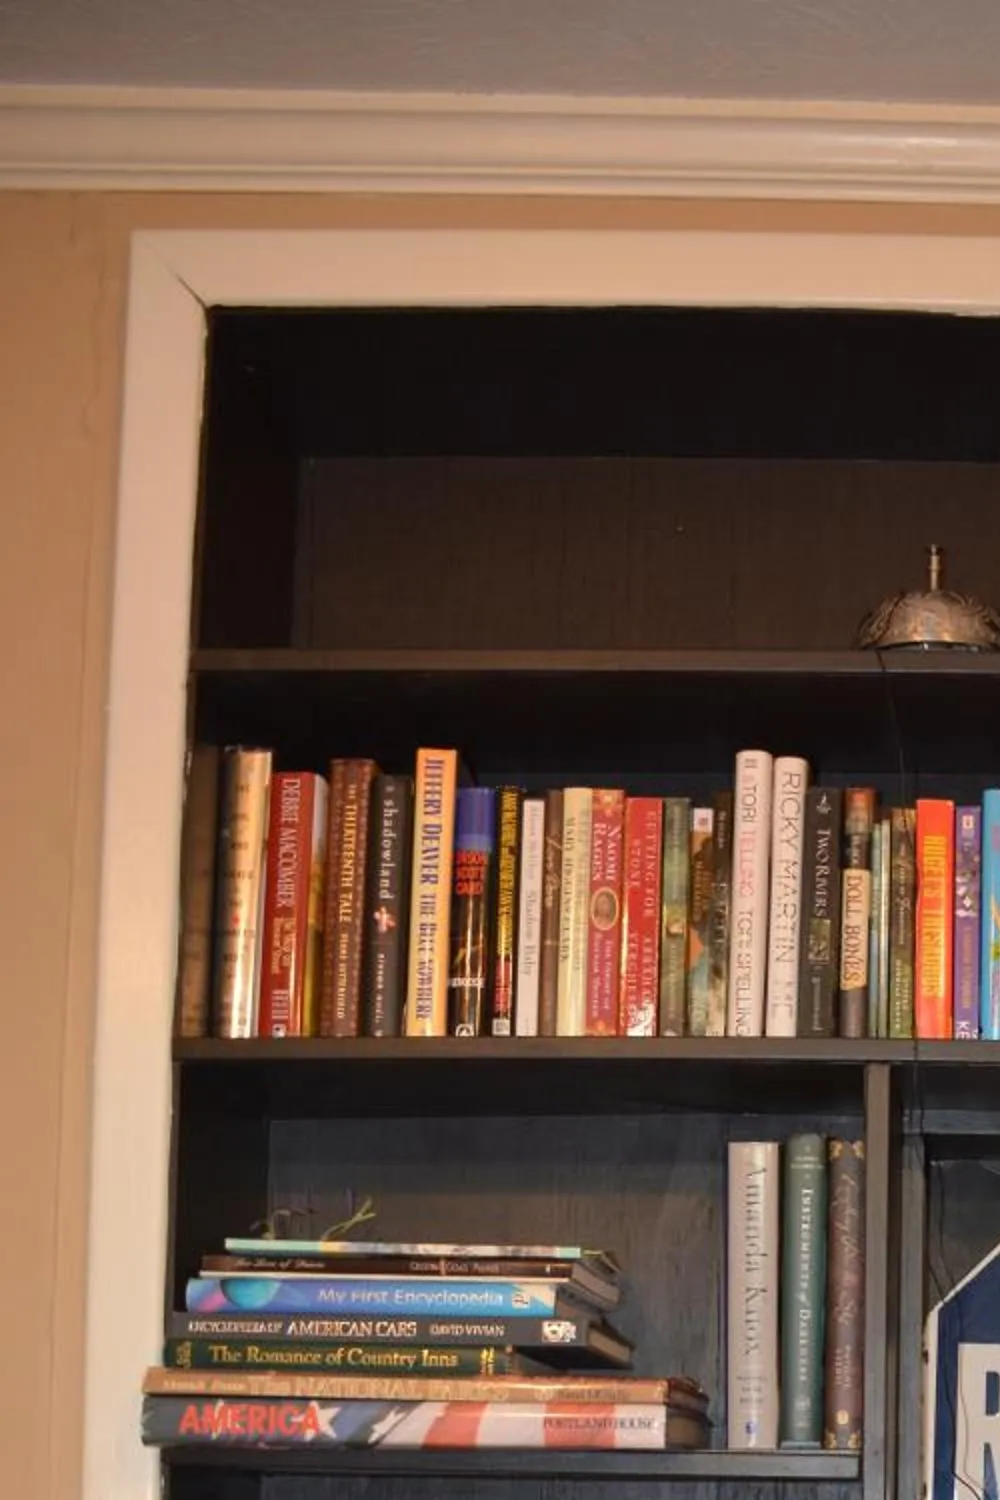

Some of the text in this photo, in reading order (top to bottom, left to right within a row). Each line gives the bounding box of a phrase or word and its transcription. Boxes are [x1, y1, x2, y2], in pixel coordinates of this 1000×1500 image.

[275, 779, 302, 908] DEBBIE MACOMBER
[339, 804, 358, 923] THIRTEENTH TALE
[378, 799, 399, 899] shadowland
[420, 759, 445, 885] JEFFERY DEAVER
[605, 826, 621, 881] NAOMI
[771, 771, 802, 1020] RICKY MARTIN ME
[815, 865, 831, 917] RIVERS
[844, 876, 863, 982] DOLL BONES
[743, 1168, 769, 1356] Amanda Knox
[798, 1189, 813, 1289] INSTRUMENTS
[287, 1321, 417, 1337] AMERICAN CARS
[318, 1289, 503, 1307] My First Encyclopedia
[798, 1308, 812, 1382] DARKNESS
[208, 1346, 458, 1368] The Romance of Country Inns
[179, 1401, 320, 1438] AMERICA
